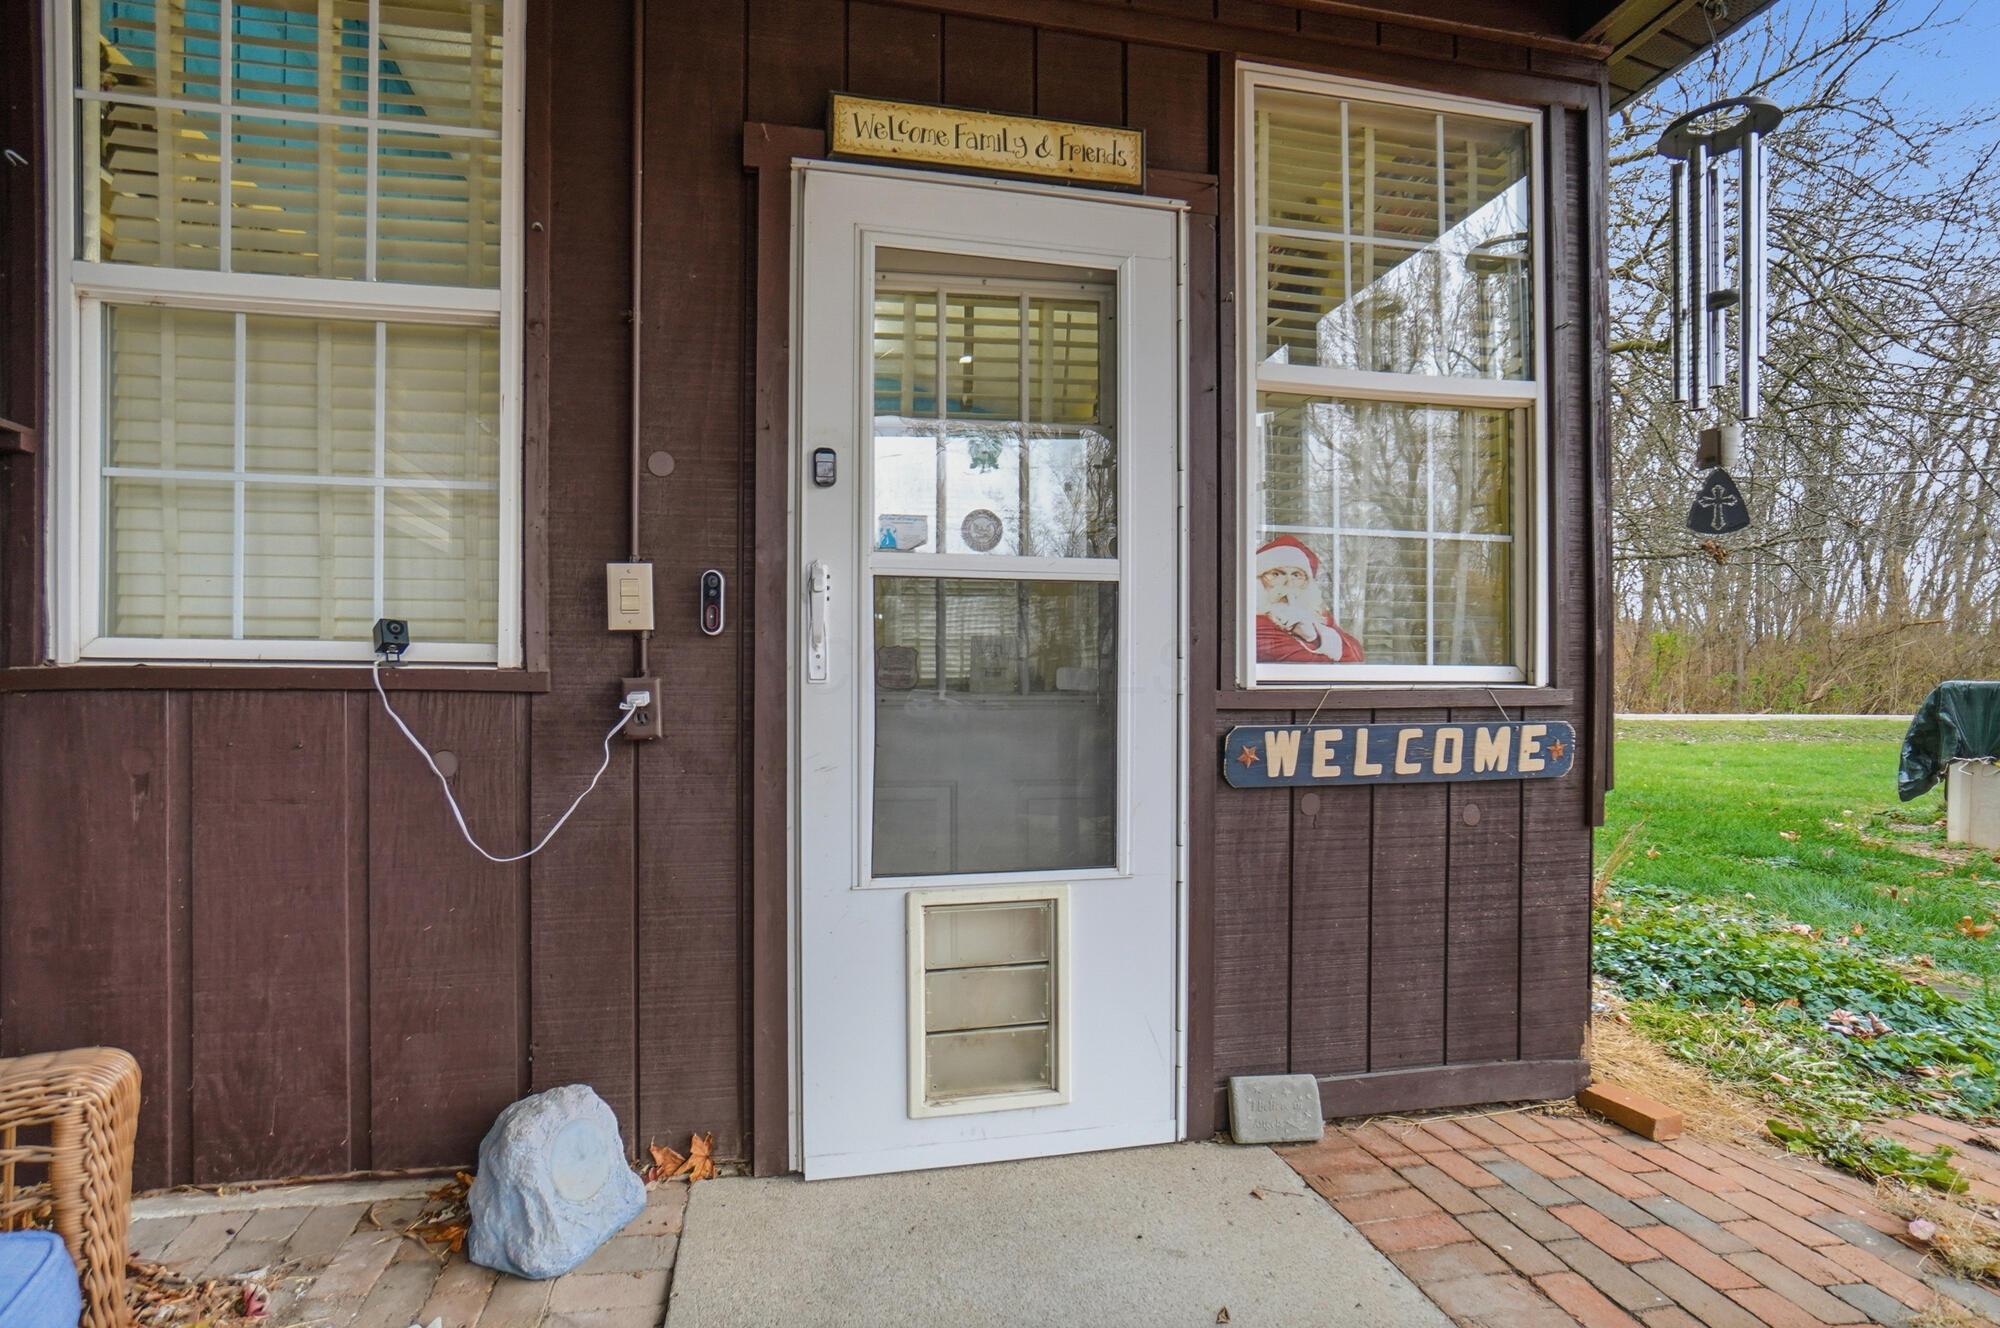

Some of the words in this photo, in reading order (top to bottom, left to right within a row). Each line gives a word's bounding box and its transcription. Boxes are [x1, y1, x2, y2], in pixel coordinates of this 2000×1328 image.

[1035, 134, 1054, 158] &
[1059, 133, 1127, 167] Friends
[1265, 724, 1547, 778] WELCOME
